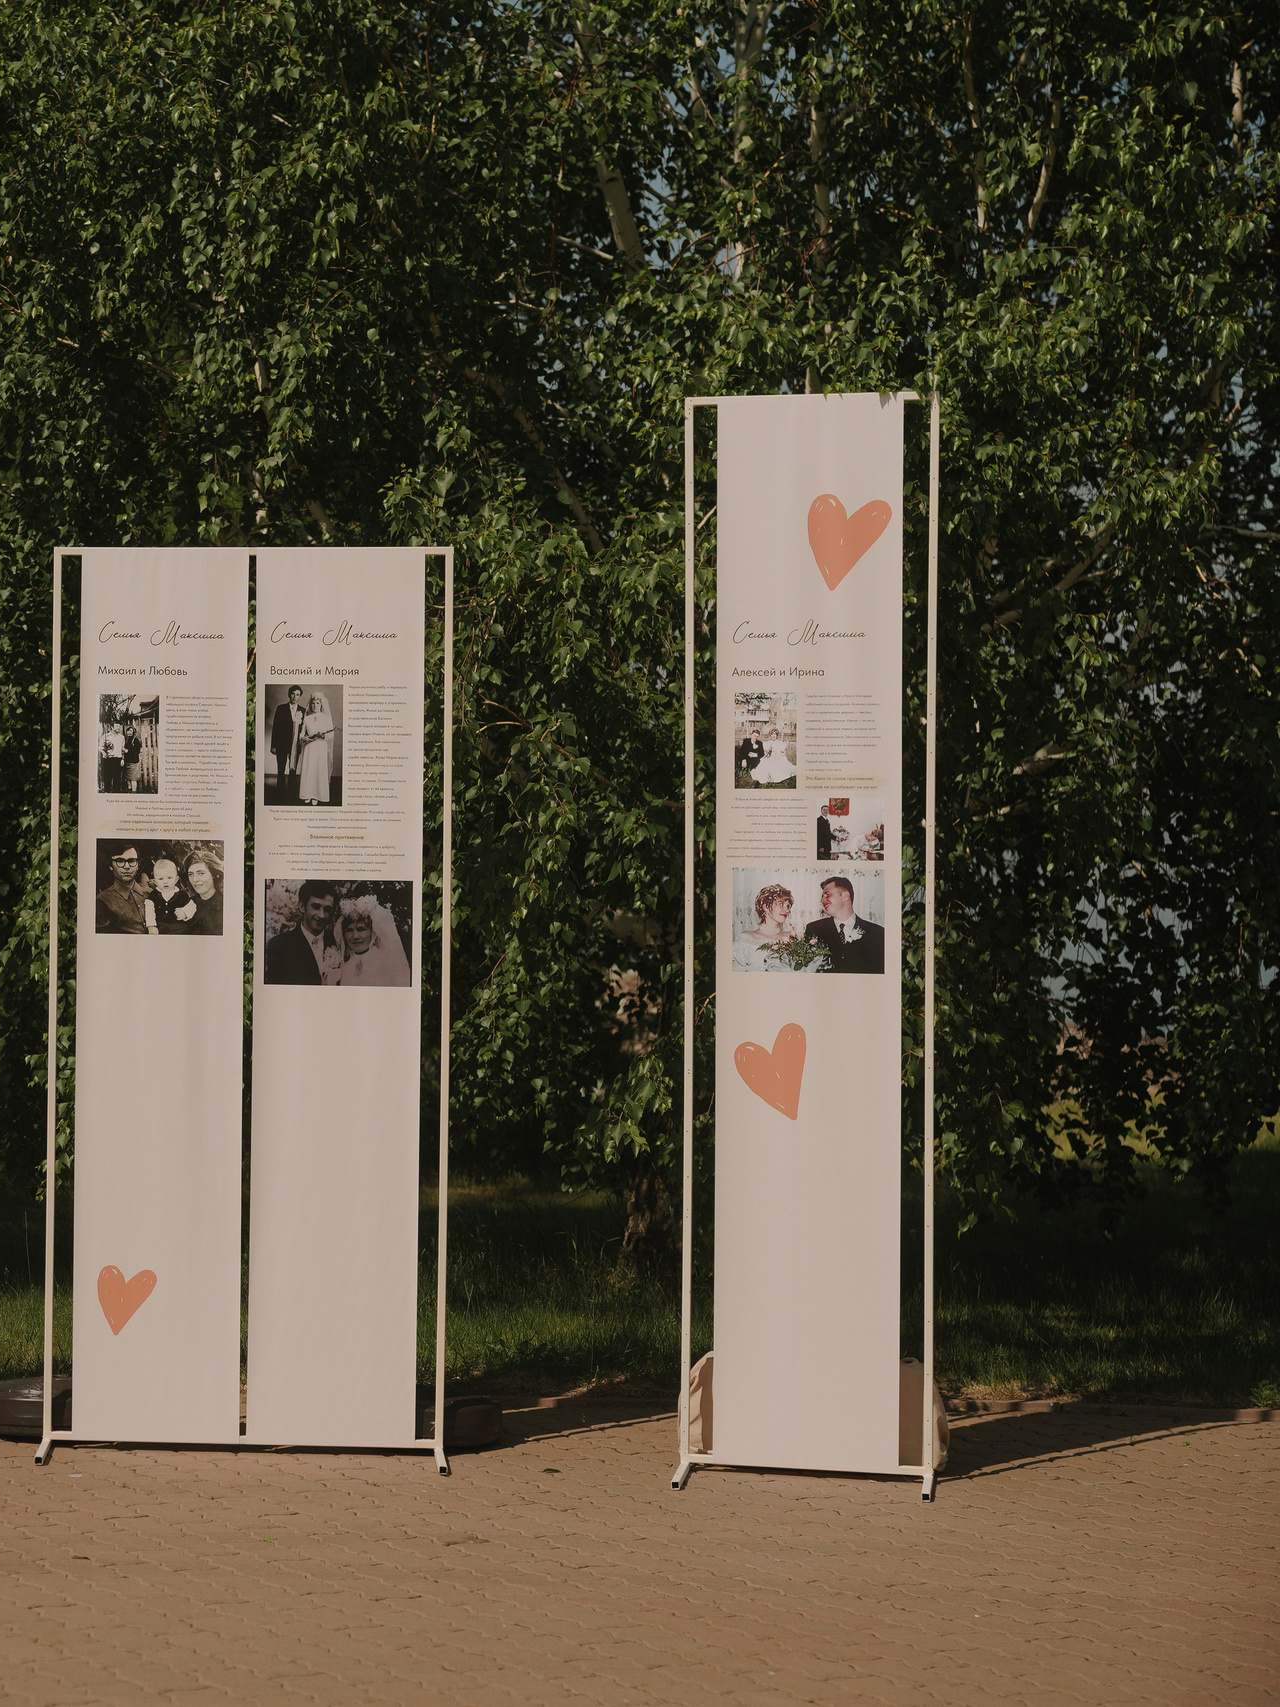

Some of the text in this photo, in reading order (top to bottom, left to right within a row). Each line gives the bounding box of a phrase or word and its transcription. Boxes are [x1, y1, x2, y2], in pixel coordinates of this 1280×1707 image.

[98, 620, 226, 647] Семья Максима
[270, 619, 399, 647] Семья Максима
[732, 618, 867, 646] Семья Максима
[97, 665, 188, 677] Михаил и Любовь
[270, 665, 360, 680] Василий и Мария
[731, 666, 826, 680] Алексей и Ирина
